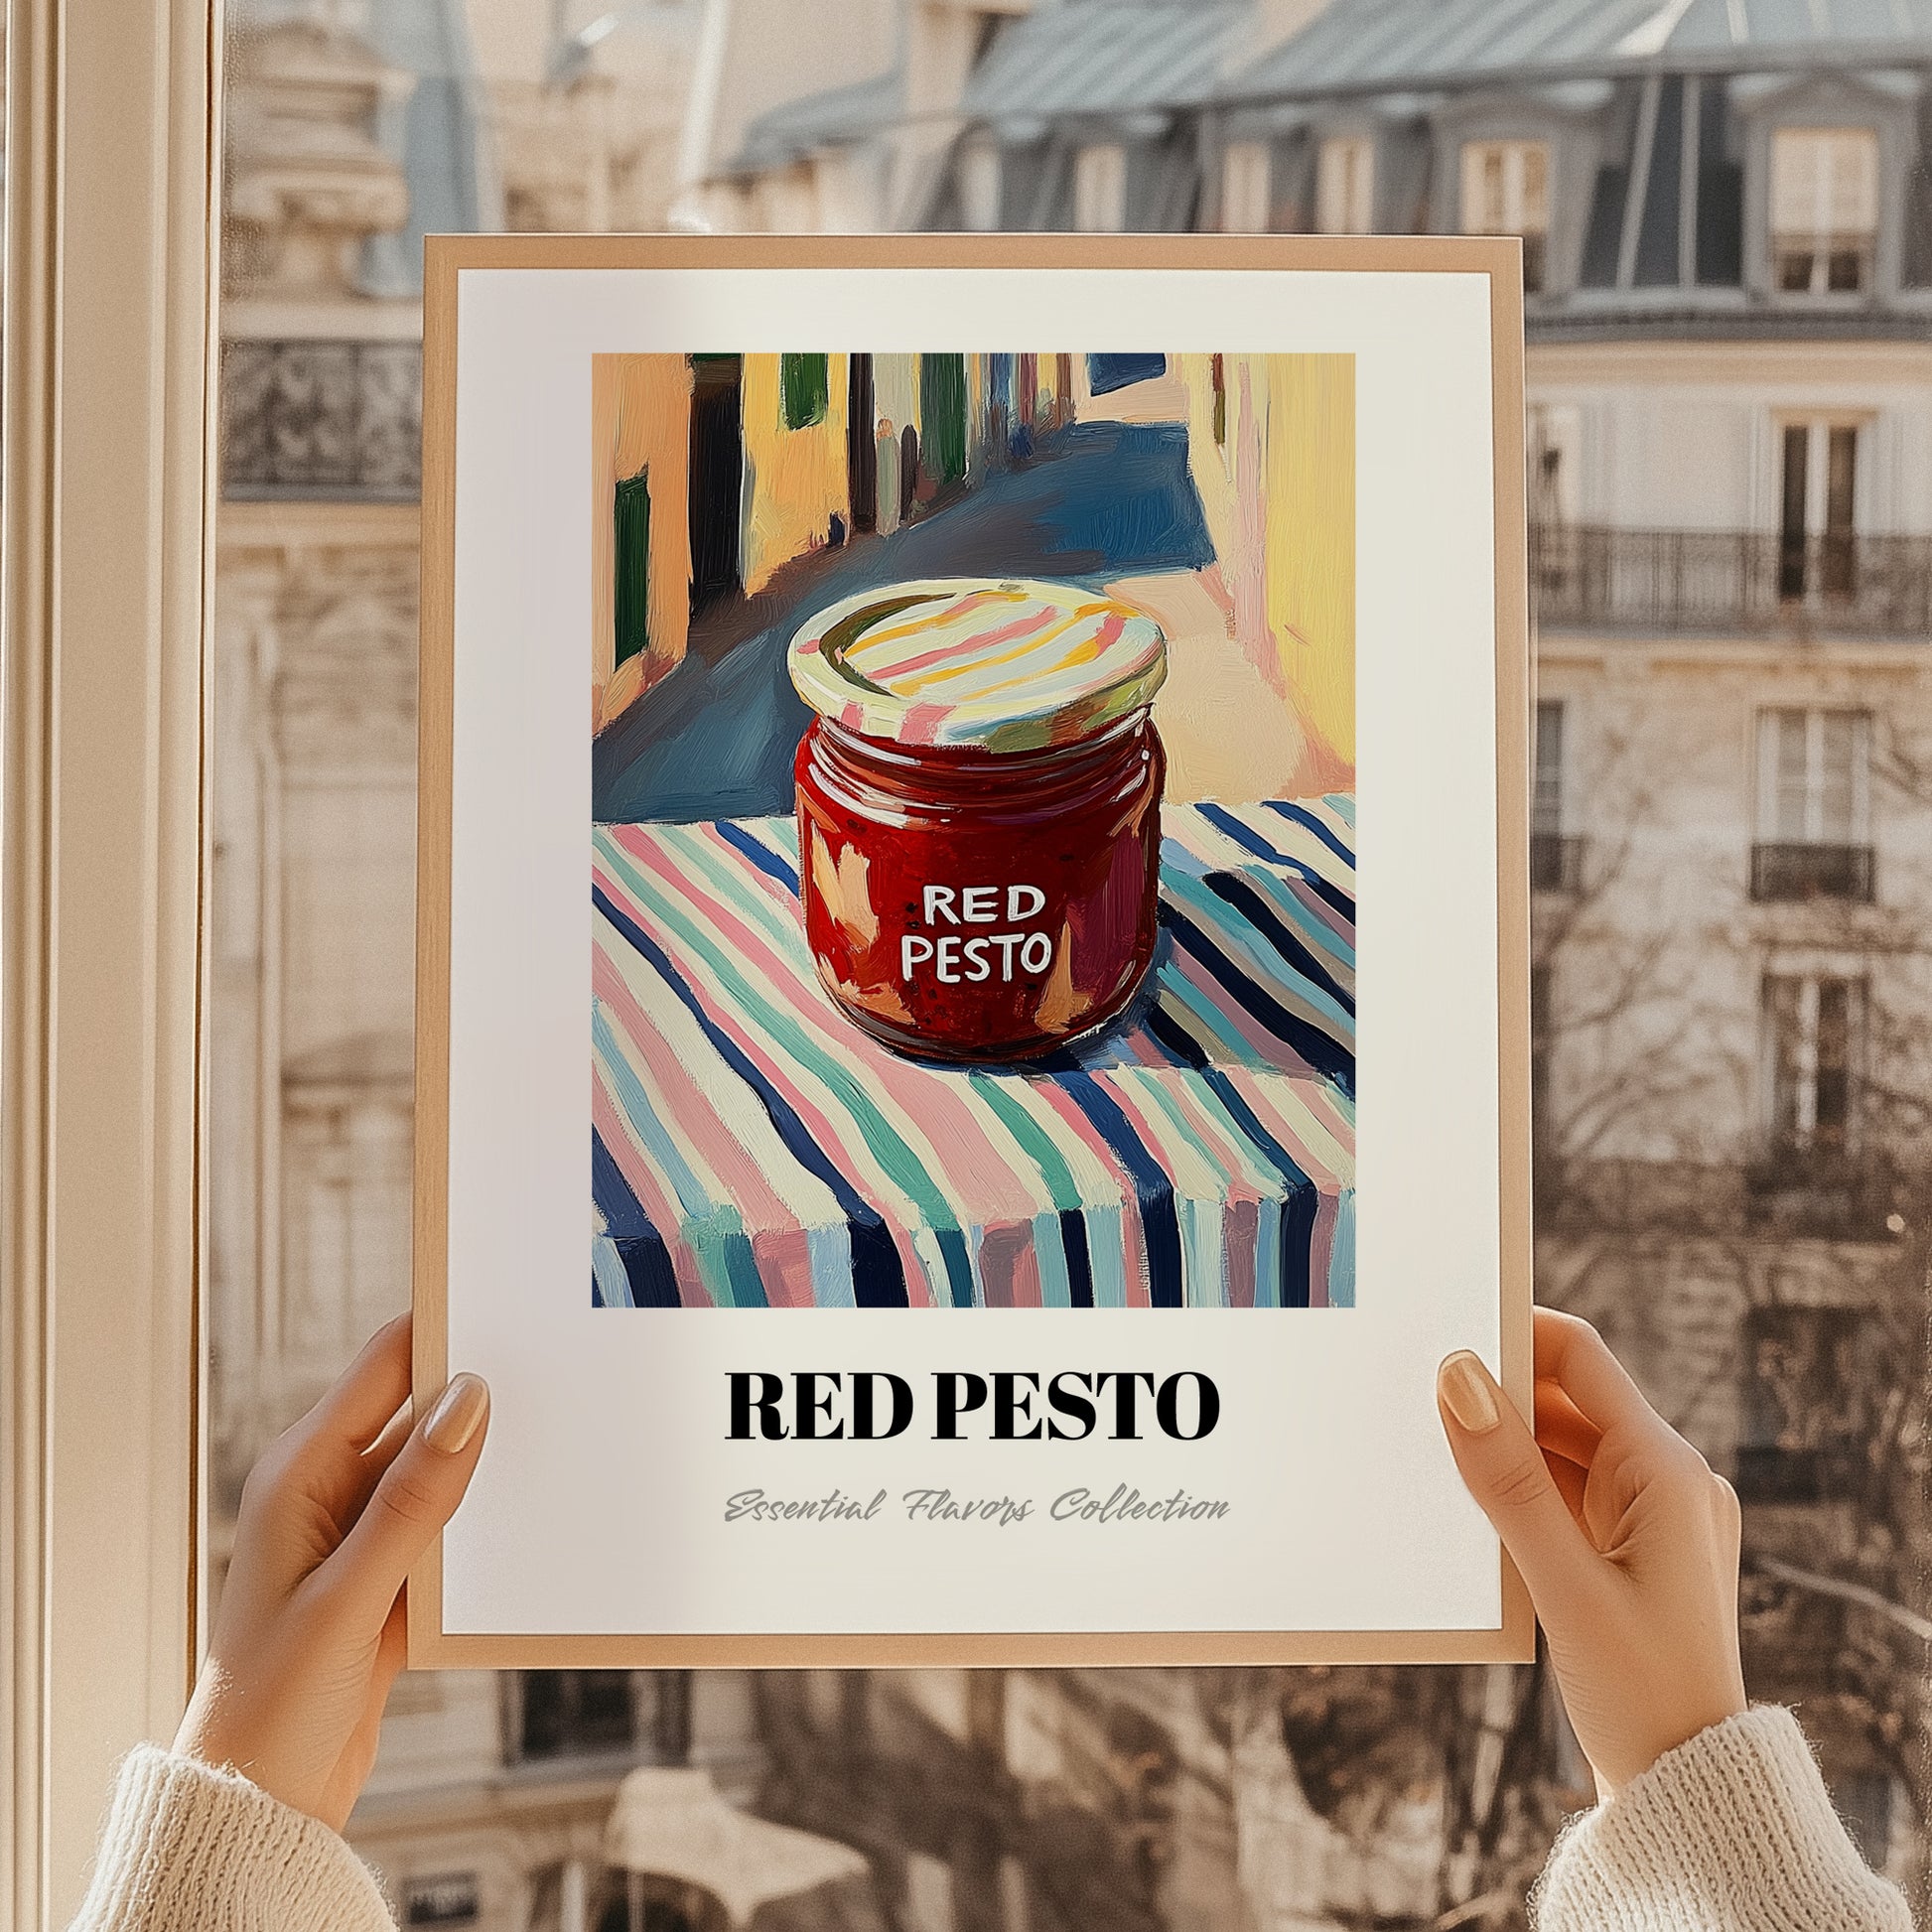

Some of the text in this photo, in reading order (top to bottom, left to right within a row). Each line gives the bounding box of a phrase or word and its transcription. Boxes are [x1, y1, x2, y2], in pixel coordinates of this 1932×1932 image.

[923, 885, 1046, 925] RED
[901, 932, 1052, 983] PESTO
[724, 1371, 1220, 1441] RED PESTO
[724, 1481, 1231, 1527] Essential Flavors Collection
